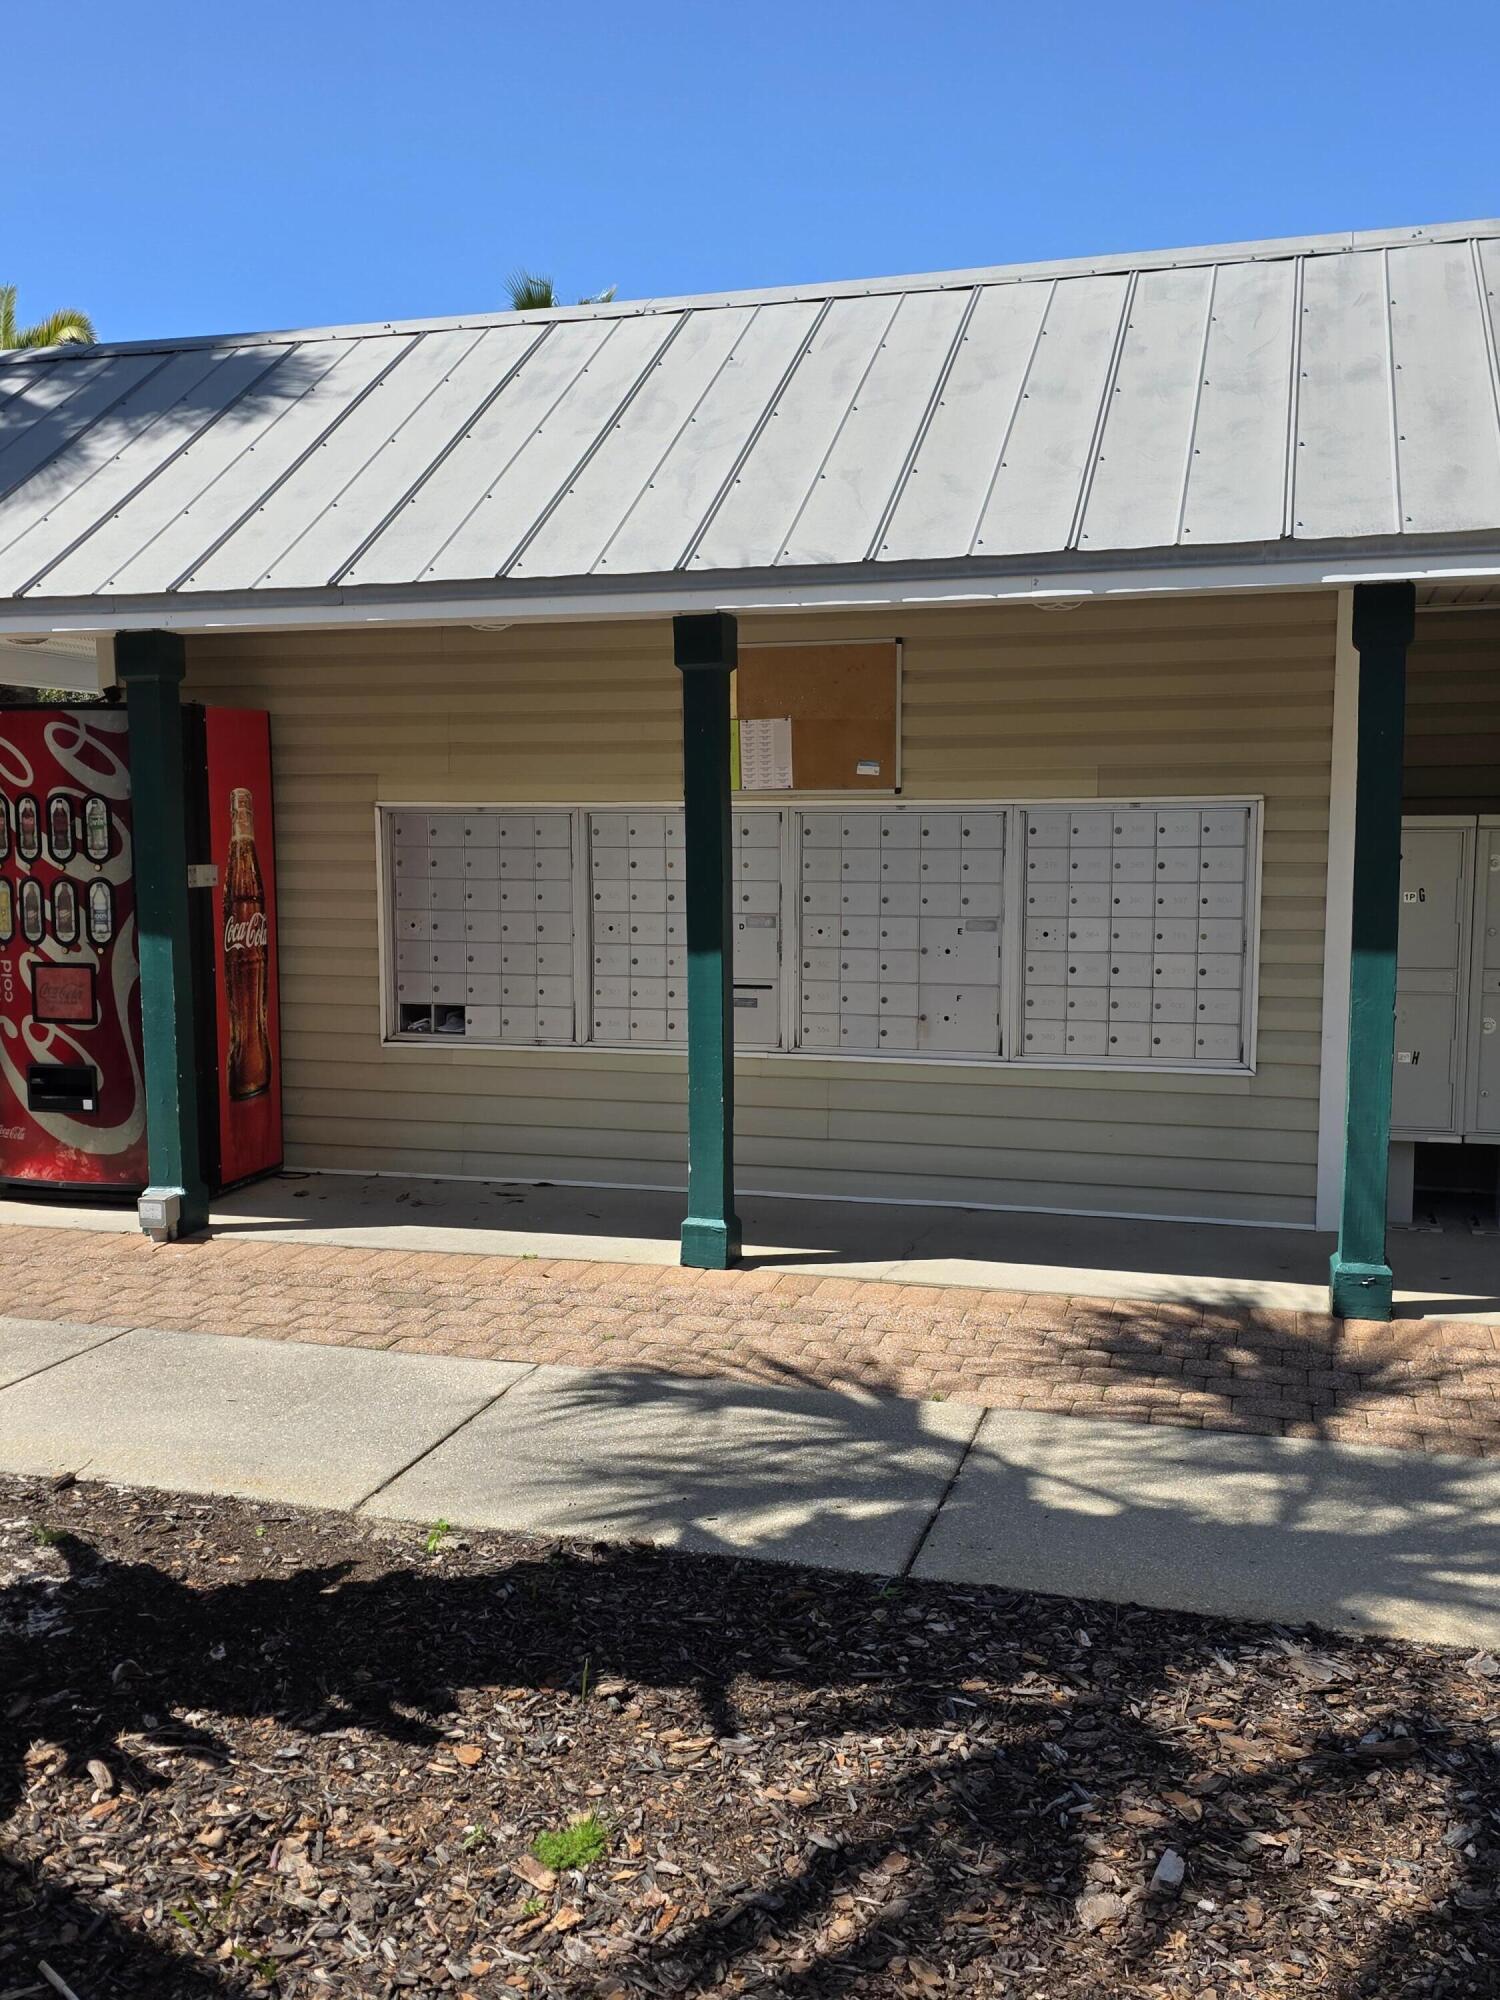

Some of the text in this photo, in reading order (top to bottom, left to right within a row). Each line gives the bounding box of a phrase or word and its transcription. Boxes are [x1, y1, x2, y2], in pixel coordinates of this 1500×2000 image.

[1405, 893, 1416, 901] 1P
[1419, 888, 1426, 903] G
[957, 927, 963, 935] E
[1411, 1050, 1420, 1065] H
